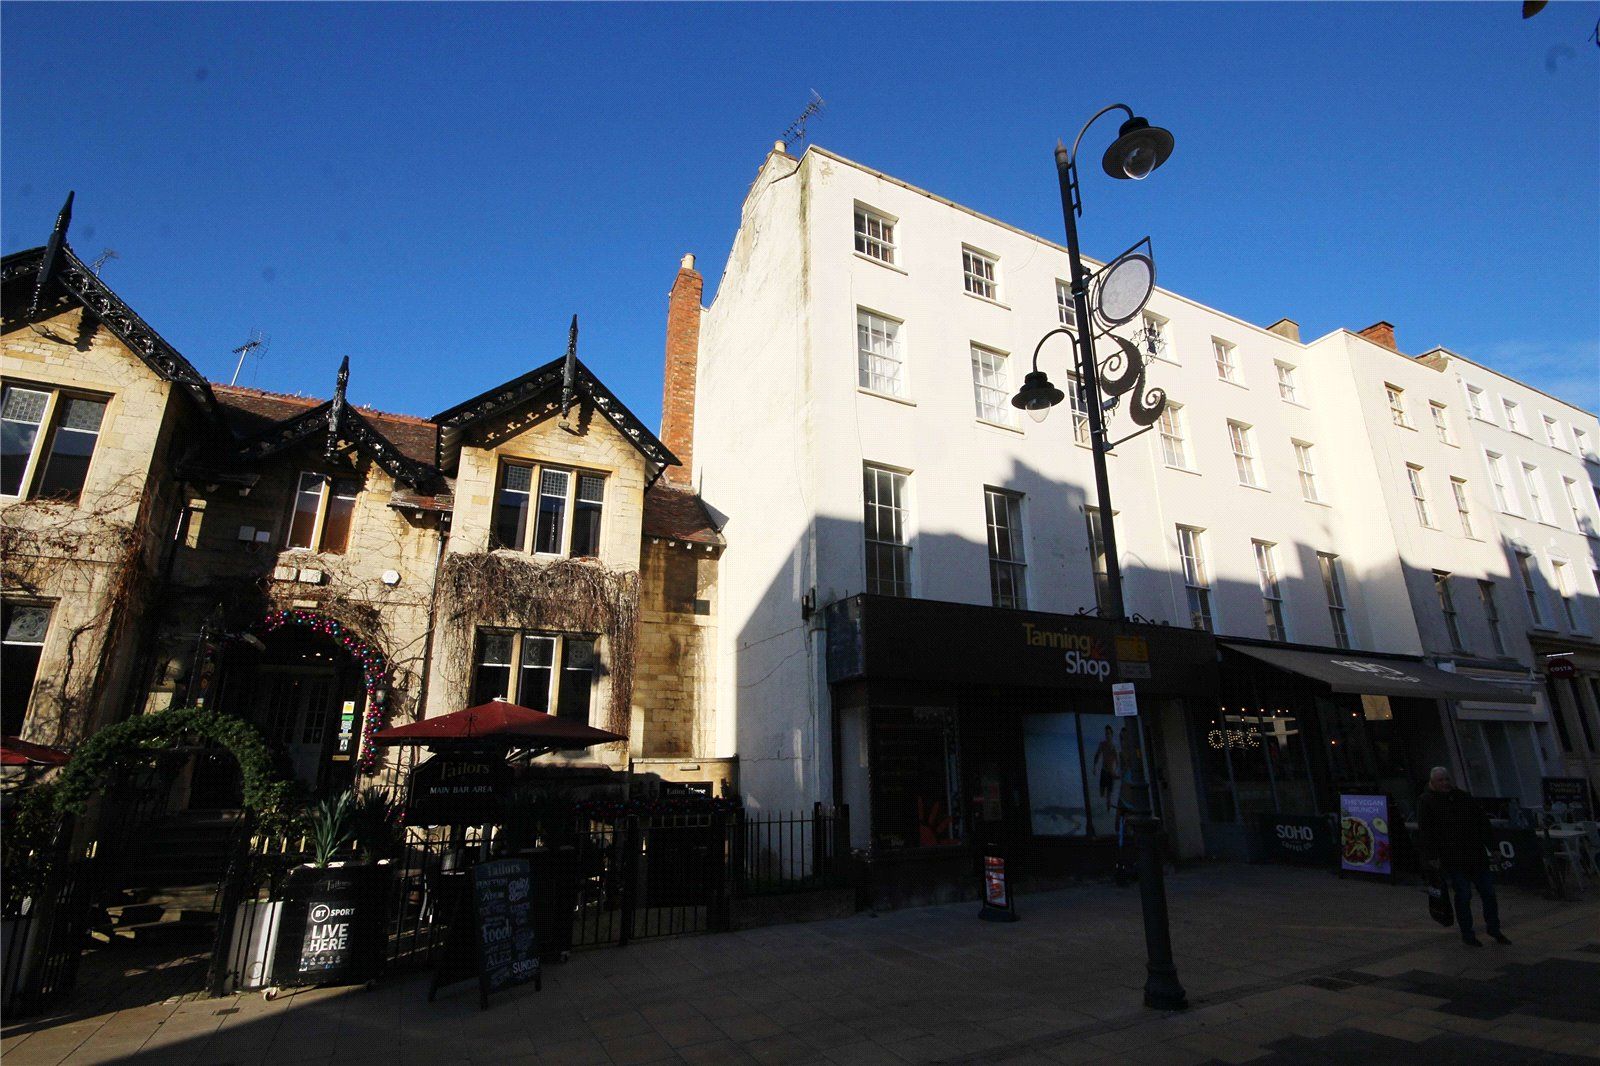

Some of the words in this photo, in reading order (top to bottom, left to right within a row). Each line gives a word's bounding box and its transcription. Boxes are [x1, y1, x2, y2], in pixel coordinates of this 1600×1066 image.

[1022, 622, 1091, 657] Tanning
[1065, 650, 1110, 682] Shop
[1550, 665, 1572, 673] COSTA
[440, 761, 490, 780] Tailors
[429, 786, 449, 795] MAIN
[452, 786, 469, 794] BAR
[471, 785, 493, 793] AREA
[1358, 799, 1383, 807] VEGAN
[1276, 824, 1314, 841] SOHO
[487, 864, 520, 877] Tailors
[330, 908, 355, 917] SPORT
[311, 923, 349, 939] LIVE
[309, 937, 347, 951] HERE
[512, 957, 539, 974] SUNDAY
